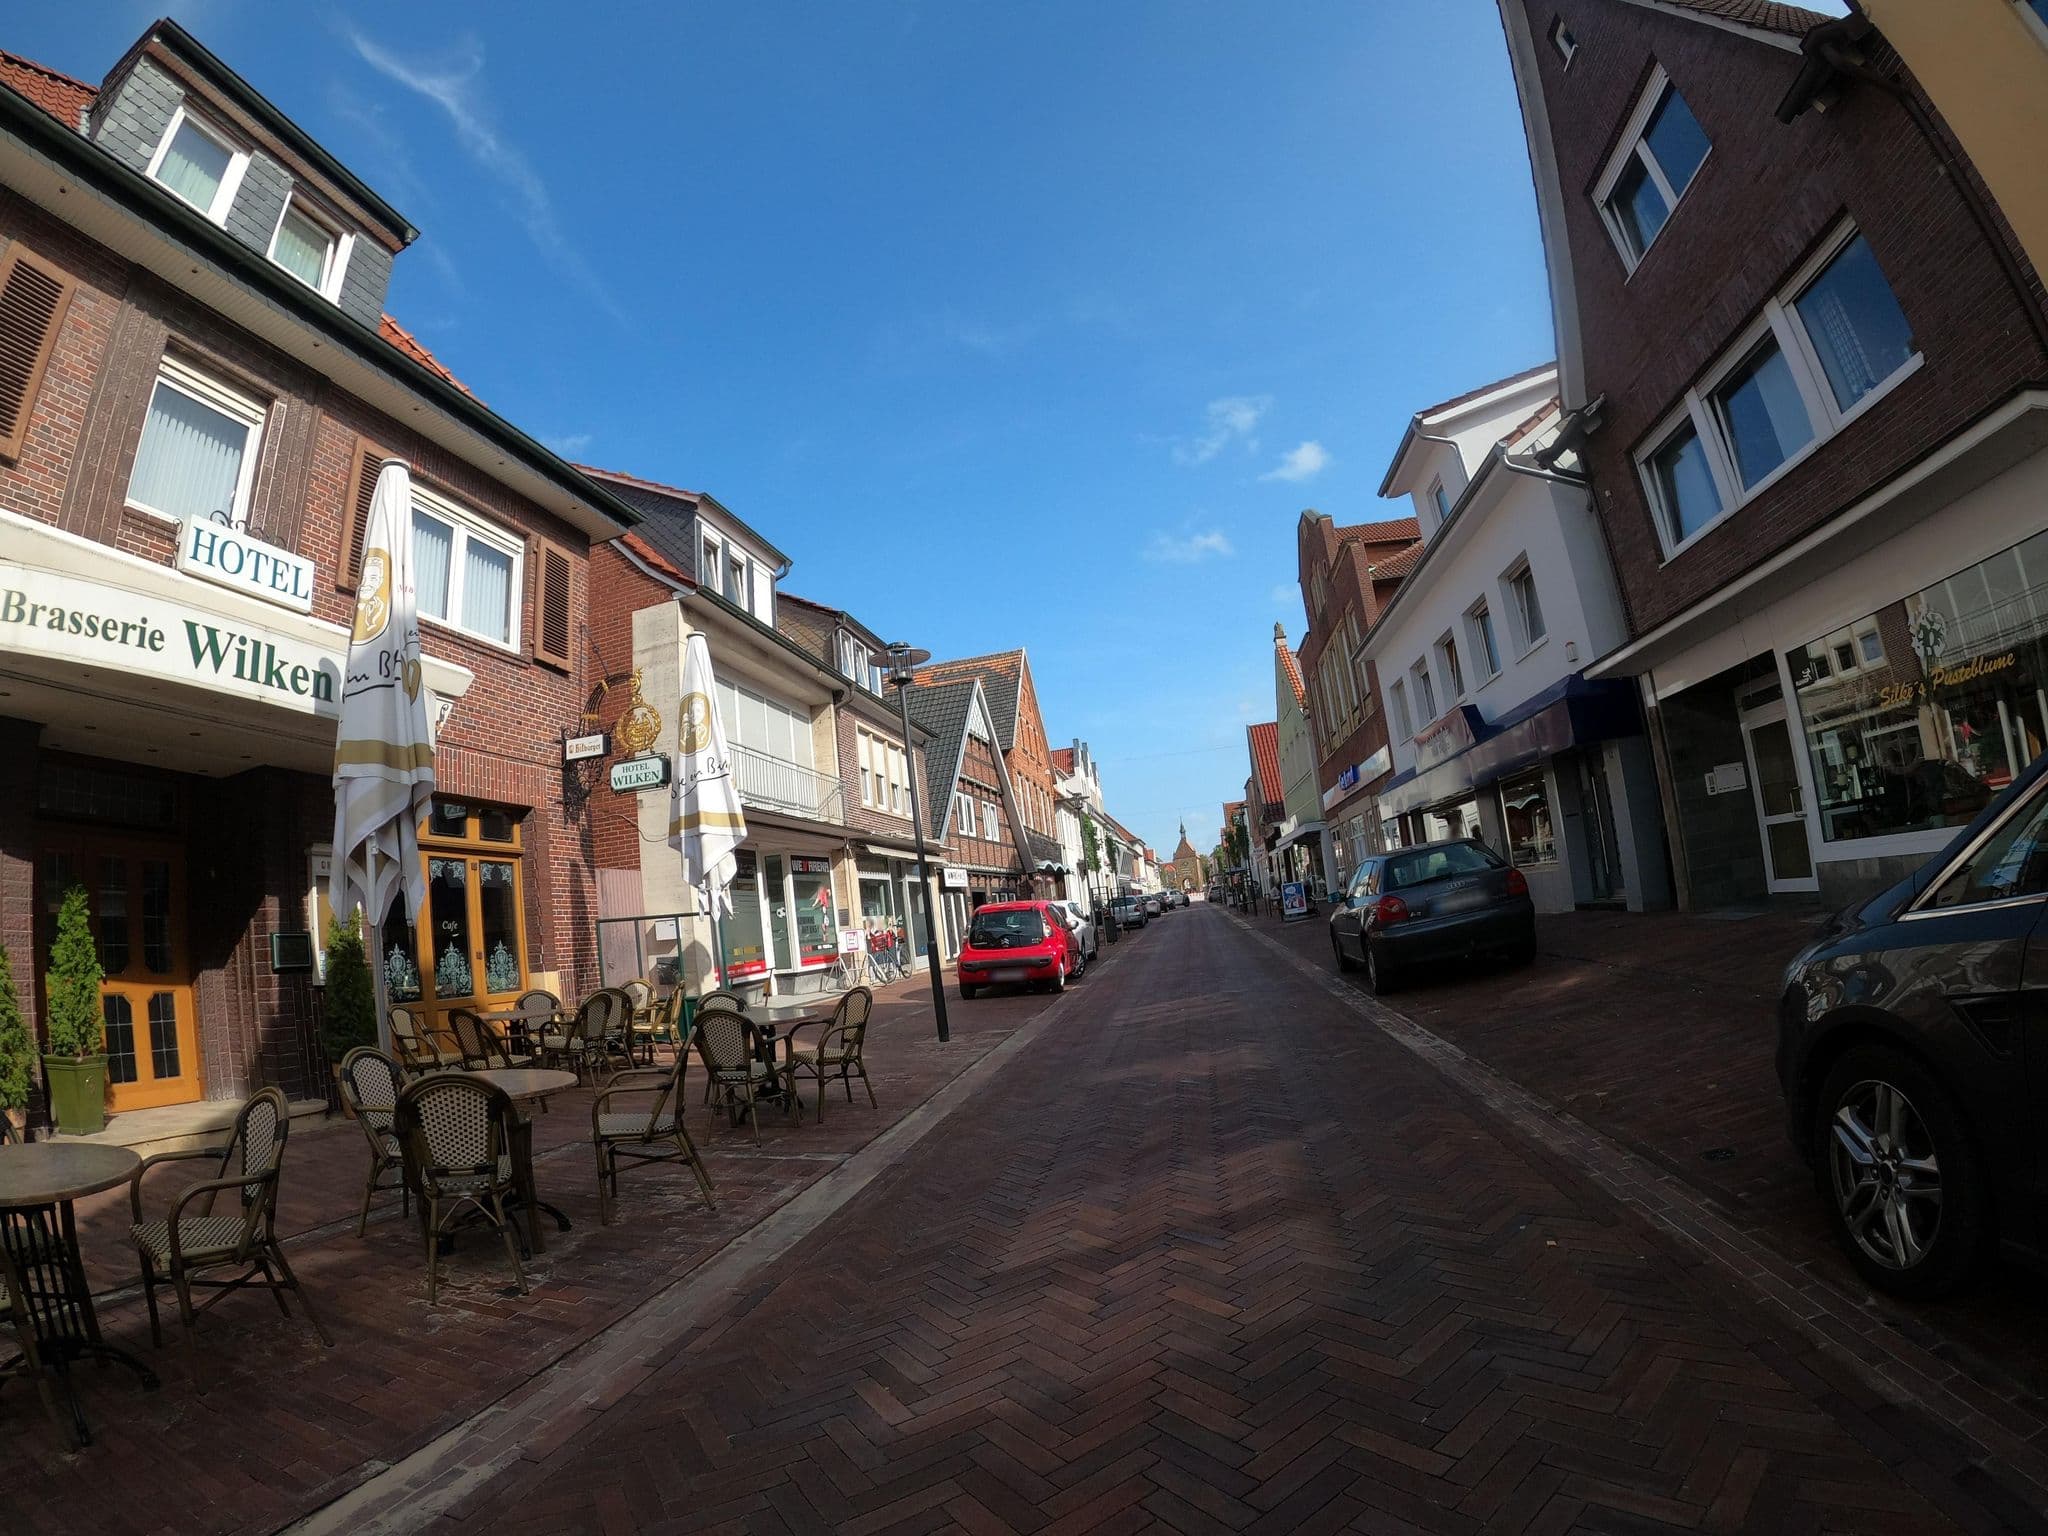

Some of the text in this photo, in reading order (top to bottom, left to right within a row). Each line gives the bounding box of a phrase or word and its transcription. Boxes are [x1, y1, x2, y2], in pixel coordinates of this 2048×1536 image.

[189, 526, 310, 600] HOTEL
[1, 588, 334, 703] Brasserie Wilken
[1930, 652, 2016, 691] Pusteblume
[613, 770, 660, 787] WILKEN
[622, 762, 650, 773] HOTEL
